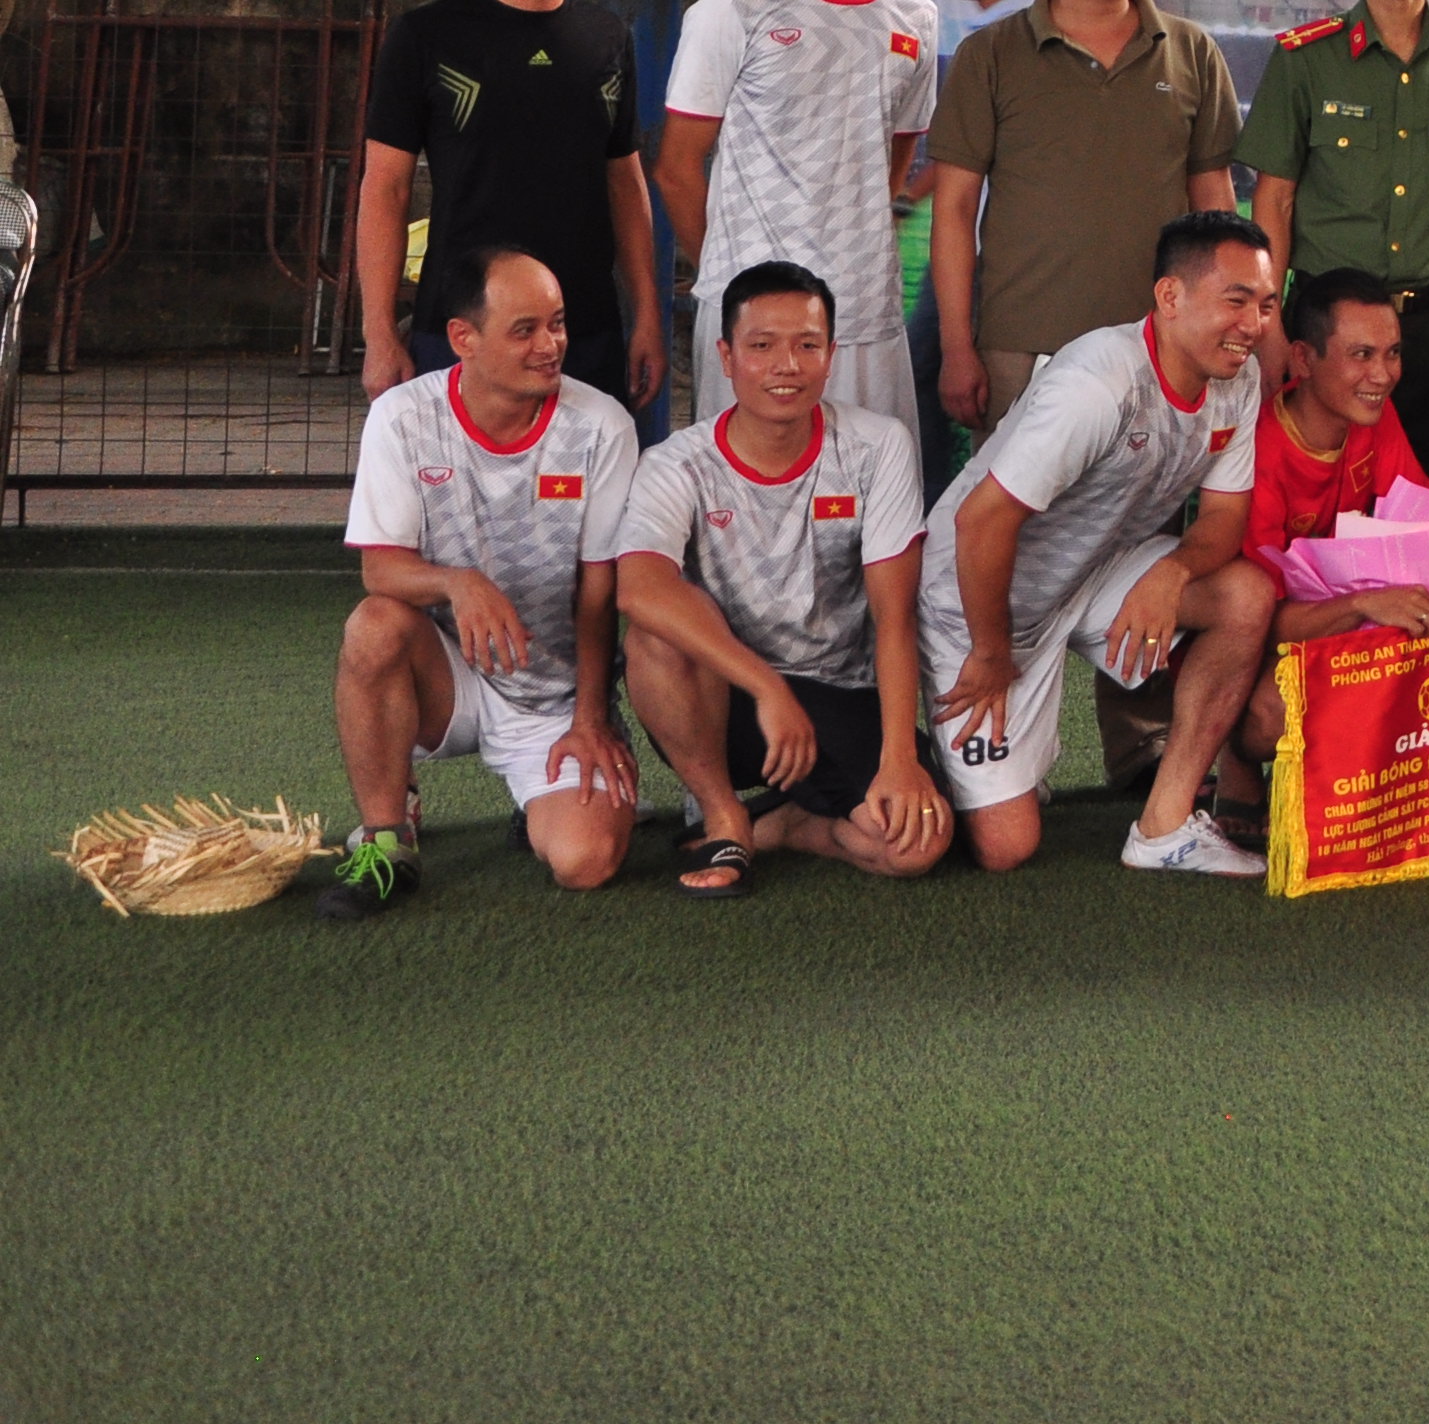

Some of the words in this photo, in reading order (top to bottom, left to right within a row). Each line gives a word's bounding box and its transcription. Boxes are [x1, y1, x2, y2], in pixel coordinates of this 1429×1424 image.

[1330, 651, 1371, 669] CÔNG
[1373, 645, 1395, 661] AN
[1331, 667, 1382, 688] PHÒNG
[1385, 659, 1416, 677] PC07
[1333, 769, 1376, 795] GIẢI
[1380, 757, 1423, 786] BÓNG
